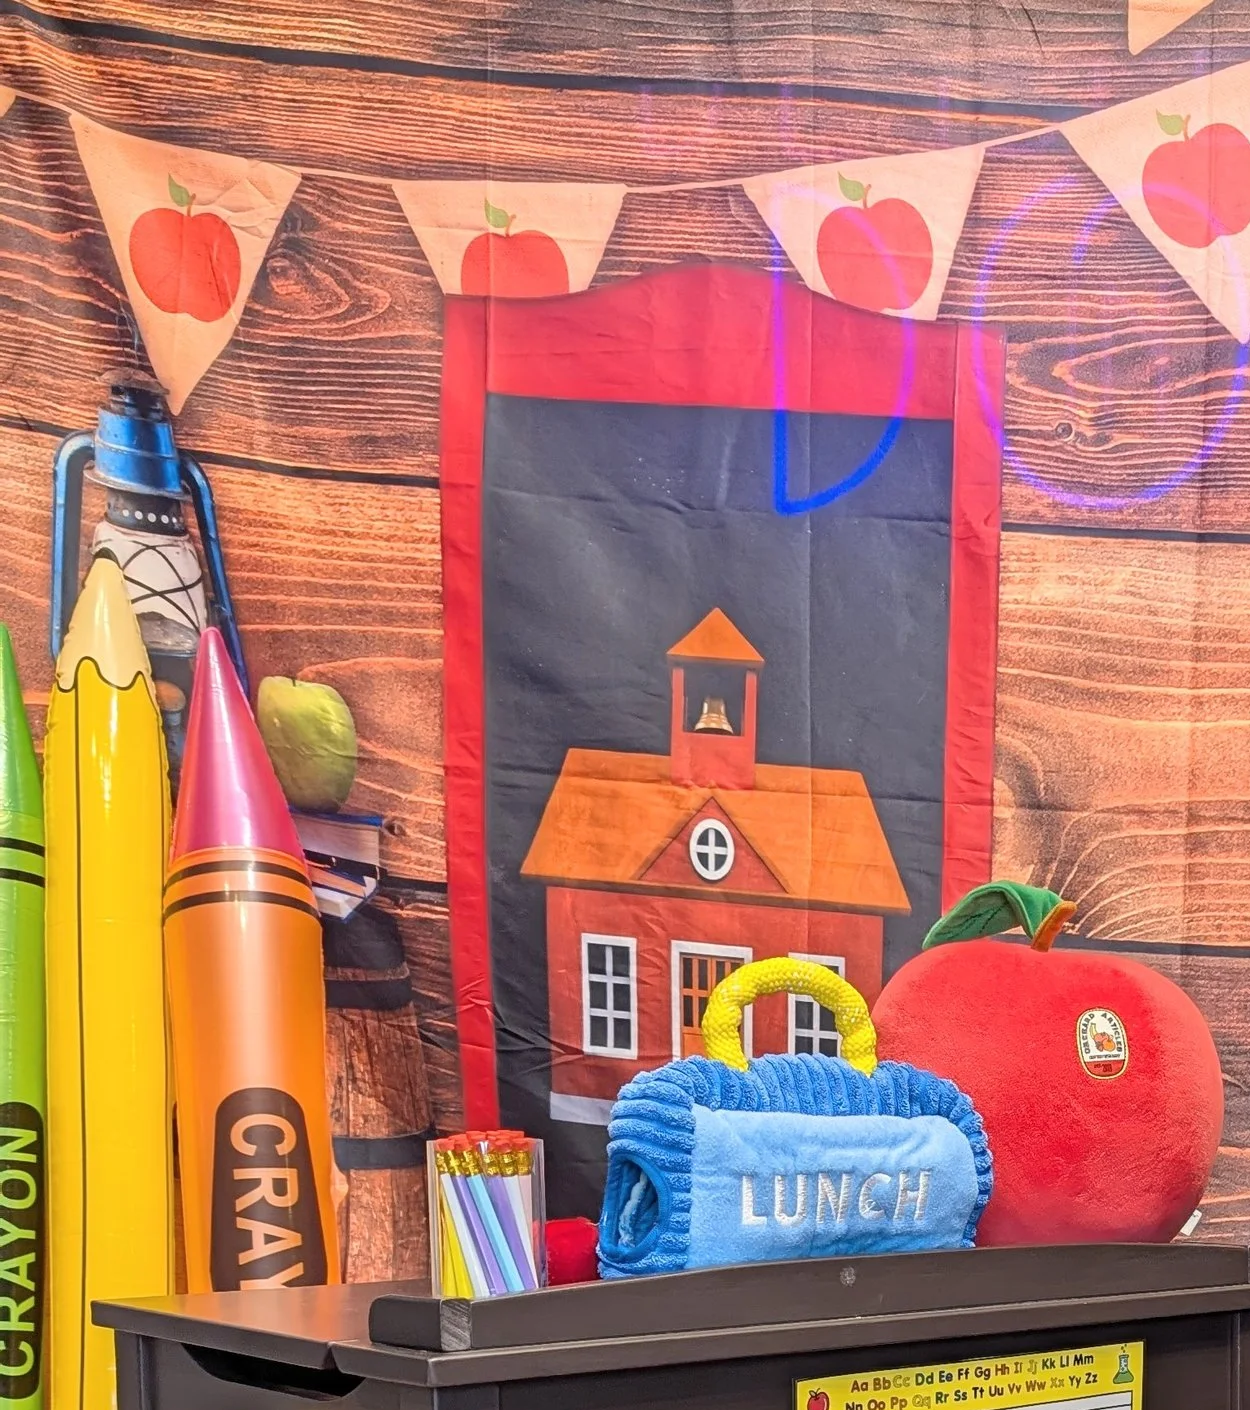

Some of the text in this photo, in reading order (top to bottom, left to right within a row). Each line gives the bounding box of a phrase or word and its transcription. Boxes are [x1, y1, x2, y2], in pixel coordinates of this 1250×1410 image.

[740, 1167, 934, 1227] LUNCH
[0, 1126, 38, 1377] CRAYON
[851, 1380, 868, 1393] Aa
[873, 1377, 891, 1391] Bb
[893, 1374, 910, 1388] Cc
[915, 1372, 934, 1386] Dd
[939, 1370, 953, 1383] Ee
[957, 1367, 970, 1380] Ff
[974, 1366, 991, 1380] Gg
[995, 1363, 1010, 1376] Hh
[1027, 1359, 1038, 1375] Jj
[1041, 1357, 1056, 1370] Kk
[1060, 1354, 1070, 1368] Ll
[1073, 1353, 1094, 1366] Mm
[912, 1394, 932, 1410] Qq
[936, 1391, 950, 1404] Rr
[954, 1389, 968, 1402] Ss
[972, 1386, 984, 1400] Tt
[988, 1384, 1004, 1398] Uu
[1008, 1382, 1022, 1395] Vv
[1025, 1380, 1046, 1392] Ww
[1050, 1376, 1065, 1389] Xx
[1068, 1375, 1082, 1389] Yy
[1085, 1372, 1098, 1384] Zz
